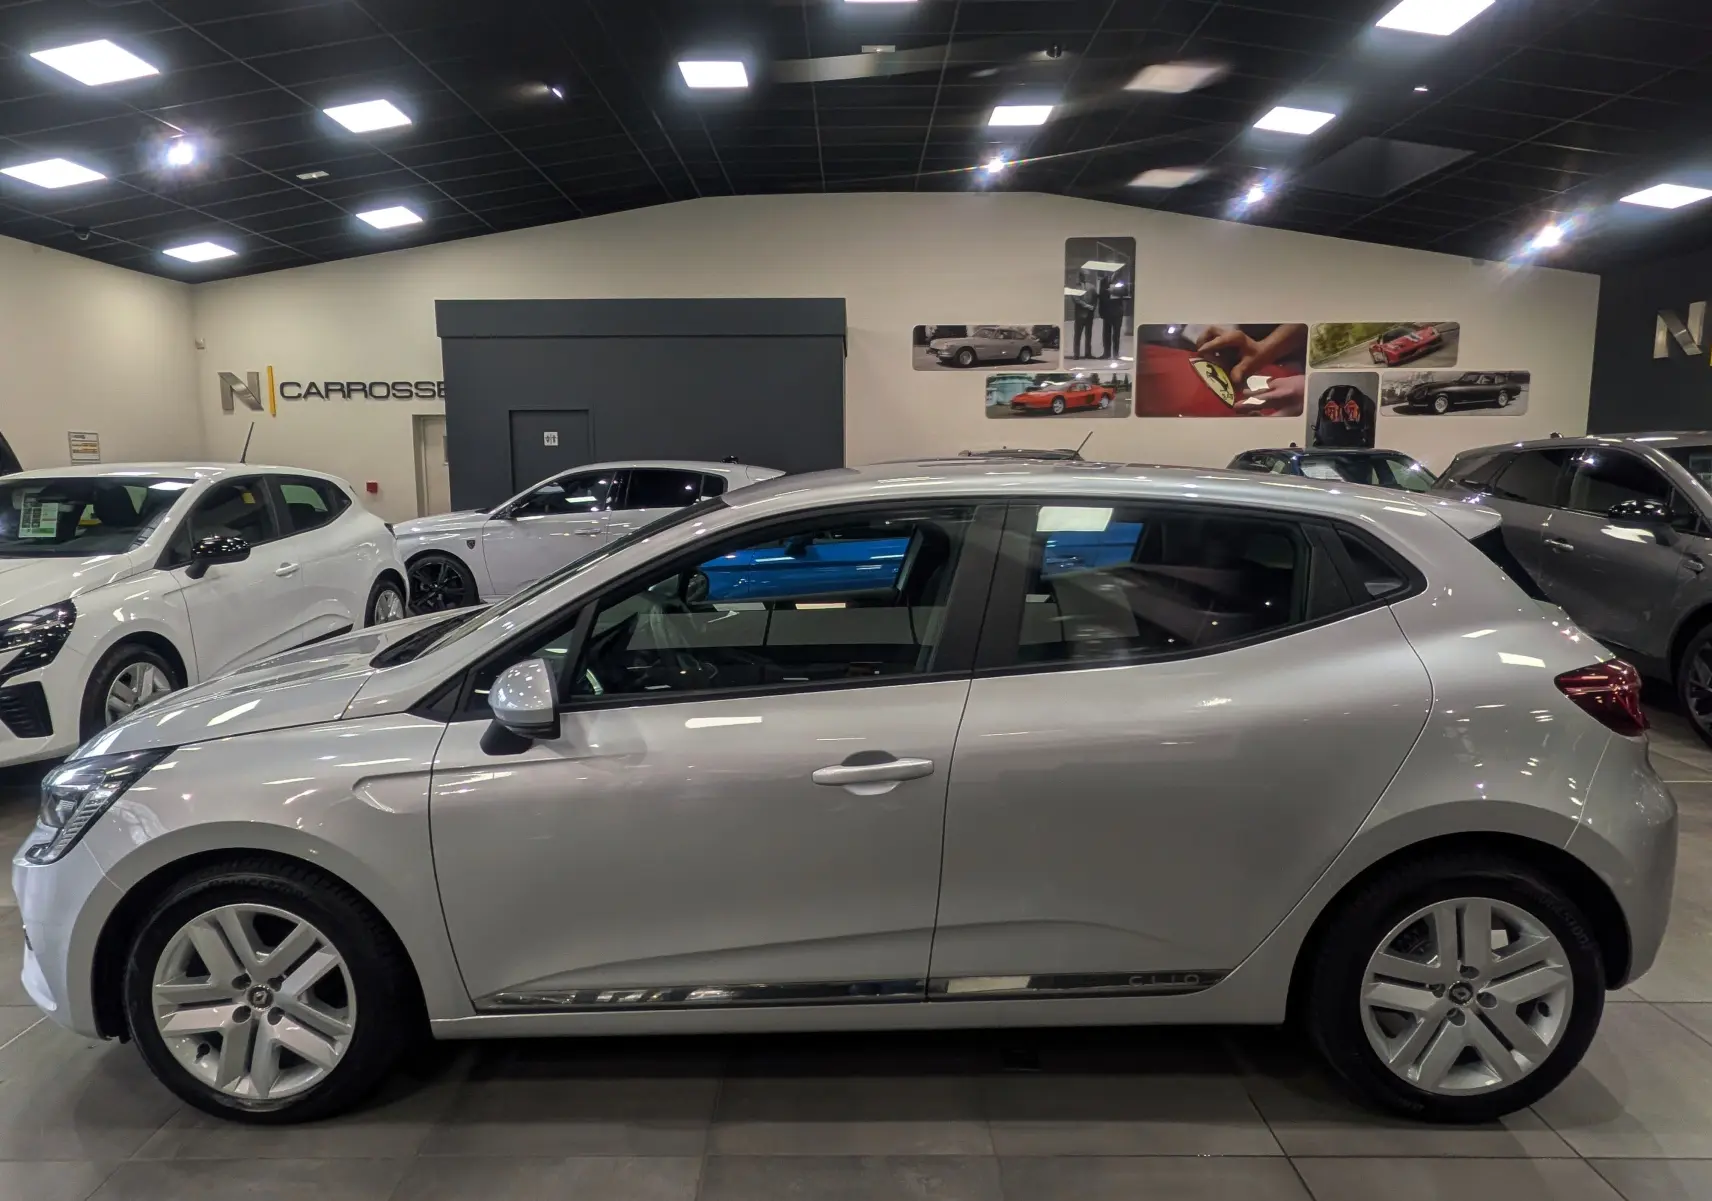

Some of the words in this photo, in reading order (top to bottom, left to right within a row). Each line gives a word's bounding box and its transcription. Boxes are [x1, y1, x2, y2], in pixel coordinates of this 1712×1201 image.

[1653, 300, 1706, 359] N
[218, 371, 264, 411] N
[1128, 973, 1200, 987] CLIO
